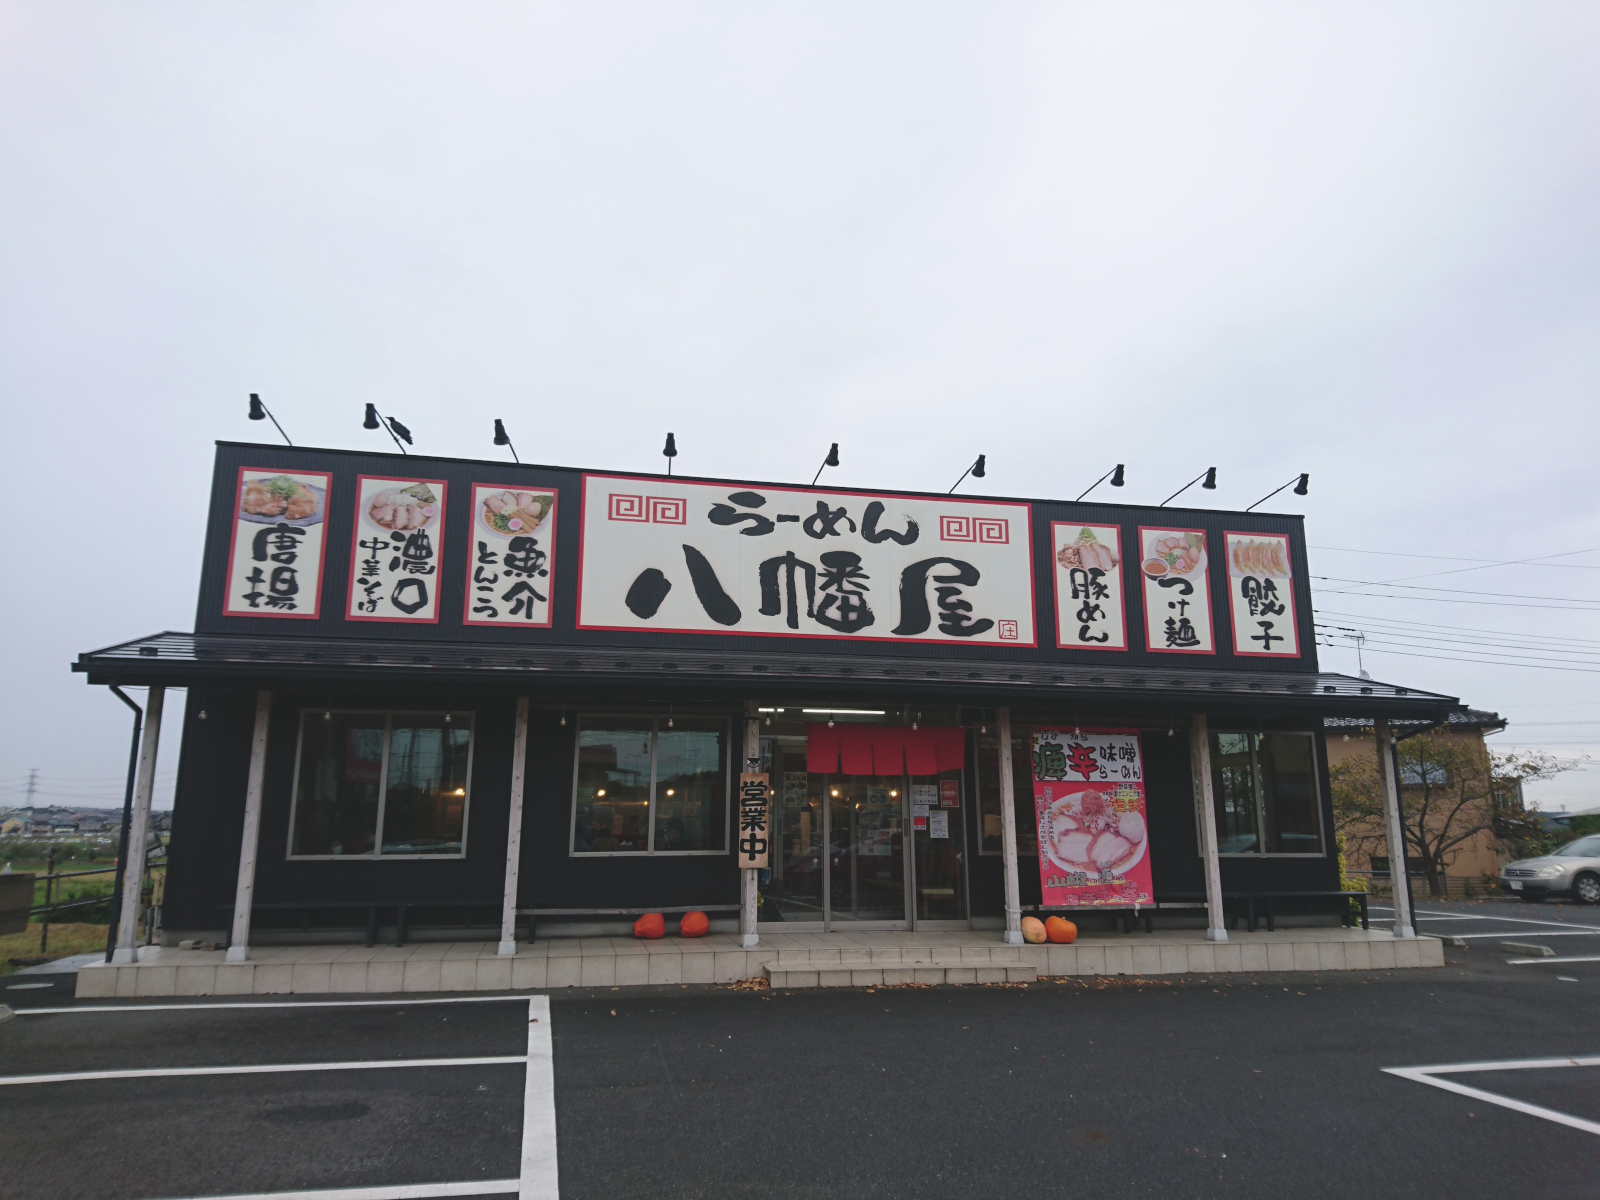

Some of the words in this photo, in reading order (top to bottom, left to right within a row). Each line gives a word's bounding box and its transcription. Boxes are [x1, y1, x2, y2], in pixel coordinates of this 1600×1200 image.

[707, 490, 921, 546] らーめん
[242, 521, 307, 612] 唐揚
[356, 536, 391, 614] 中華そば
[388, 527, 437, 615] 濃口
[472, 540, 499, 618] とんこつ
[501, 536, 549, 620] 魚介
[624, 543, 995, 637] 八幡屋
[1069, 567, 1111, 643] 豚めん
[1157, 577, 1201, 648] つけ麺
[1241, 575, 1286, 651] 餃子
[1099, 763, 1141, 780] らーめん
[740, 780, 768, 861] 営業中
